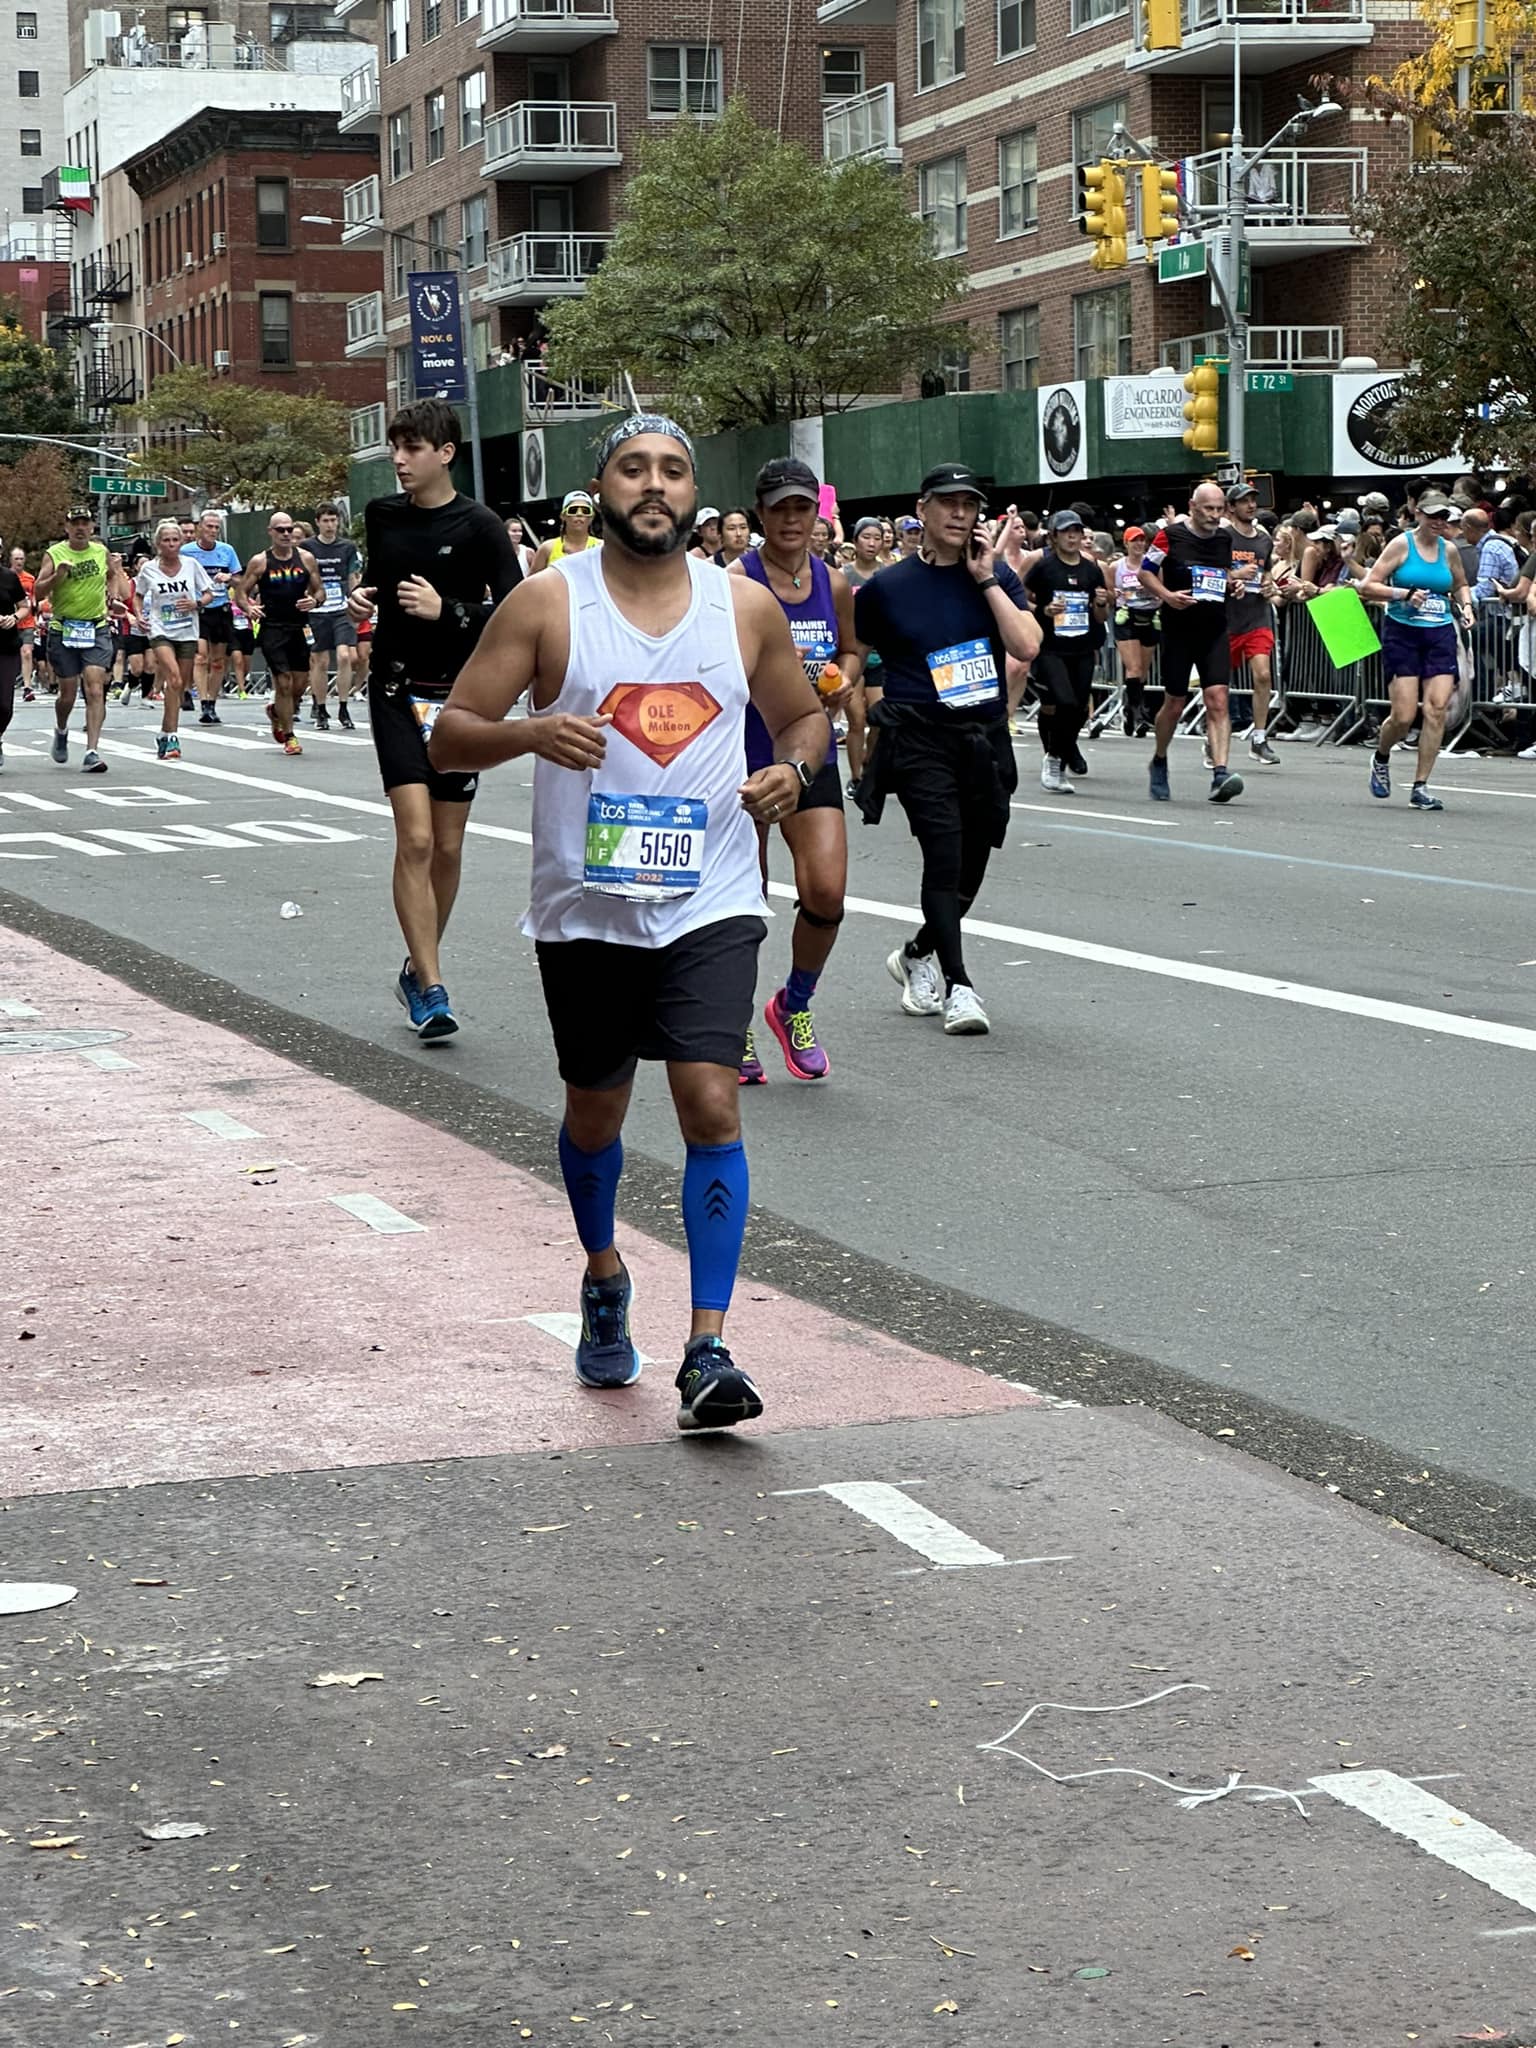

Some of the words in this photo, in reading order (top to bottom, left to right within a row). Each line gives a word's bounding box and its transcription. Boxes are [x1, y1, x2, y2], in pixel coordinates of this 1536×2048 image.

[420, 334, 445, 344] NOV.
[446, 334, 453, 342] 6
[422, 359, 456, 368] move
[1252, 375, 1259, 389] E
[1263, 375, 1275, 389] 72
[1133, 388, 1183, 405] ACCARDO
[1124, 405, 1182, 420] ENGINEERING
[106, 480, 115, 491] E
[118, 481, 131, 491] 71
[135, 482, 151, 493] St
[269, 566, 304, 583] NYC
[157, 579, 189, 594] INX
[790, 620, 827, 630] AGAINST
[647, 704, 675, 719] OLE
[600, 801, 626, 819] tcs
[672, 816, 693, 824] TATA
[598, 828, 609, 841] 4
[598, 847, 608, 860] F
[640, 831, 692, 867] 51519
